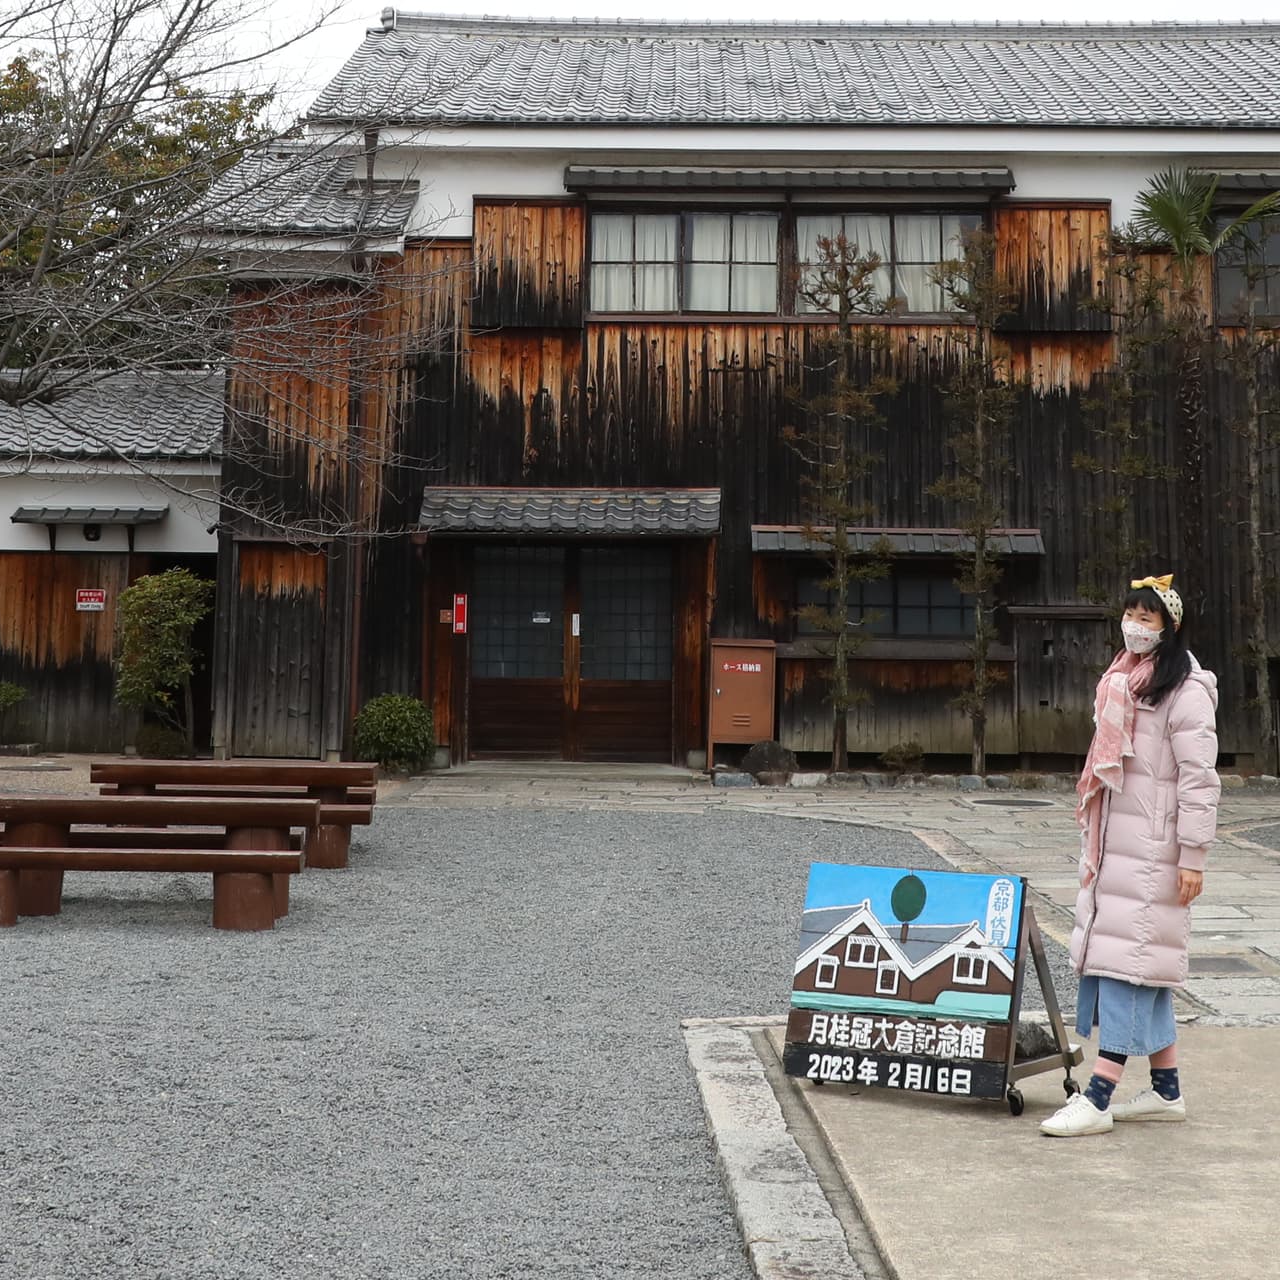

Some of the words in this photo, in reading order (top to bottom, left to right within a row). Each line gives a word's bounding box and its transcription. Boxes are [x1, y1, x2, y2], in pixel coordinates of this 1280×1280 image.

[808, 1014, 986, 1059] 月桂冠大倉記念館
[806, 1054, 879, 1085] 2023年
